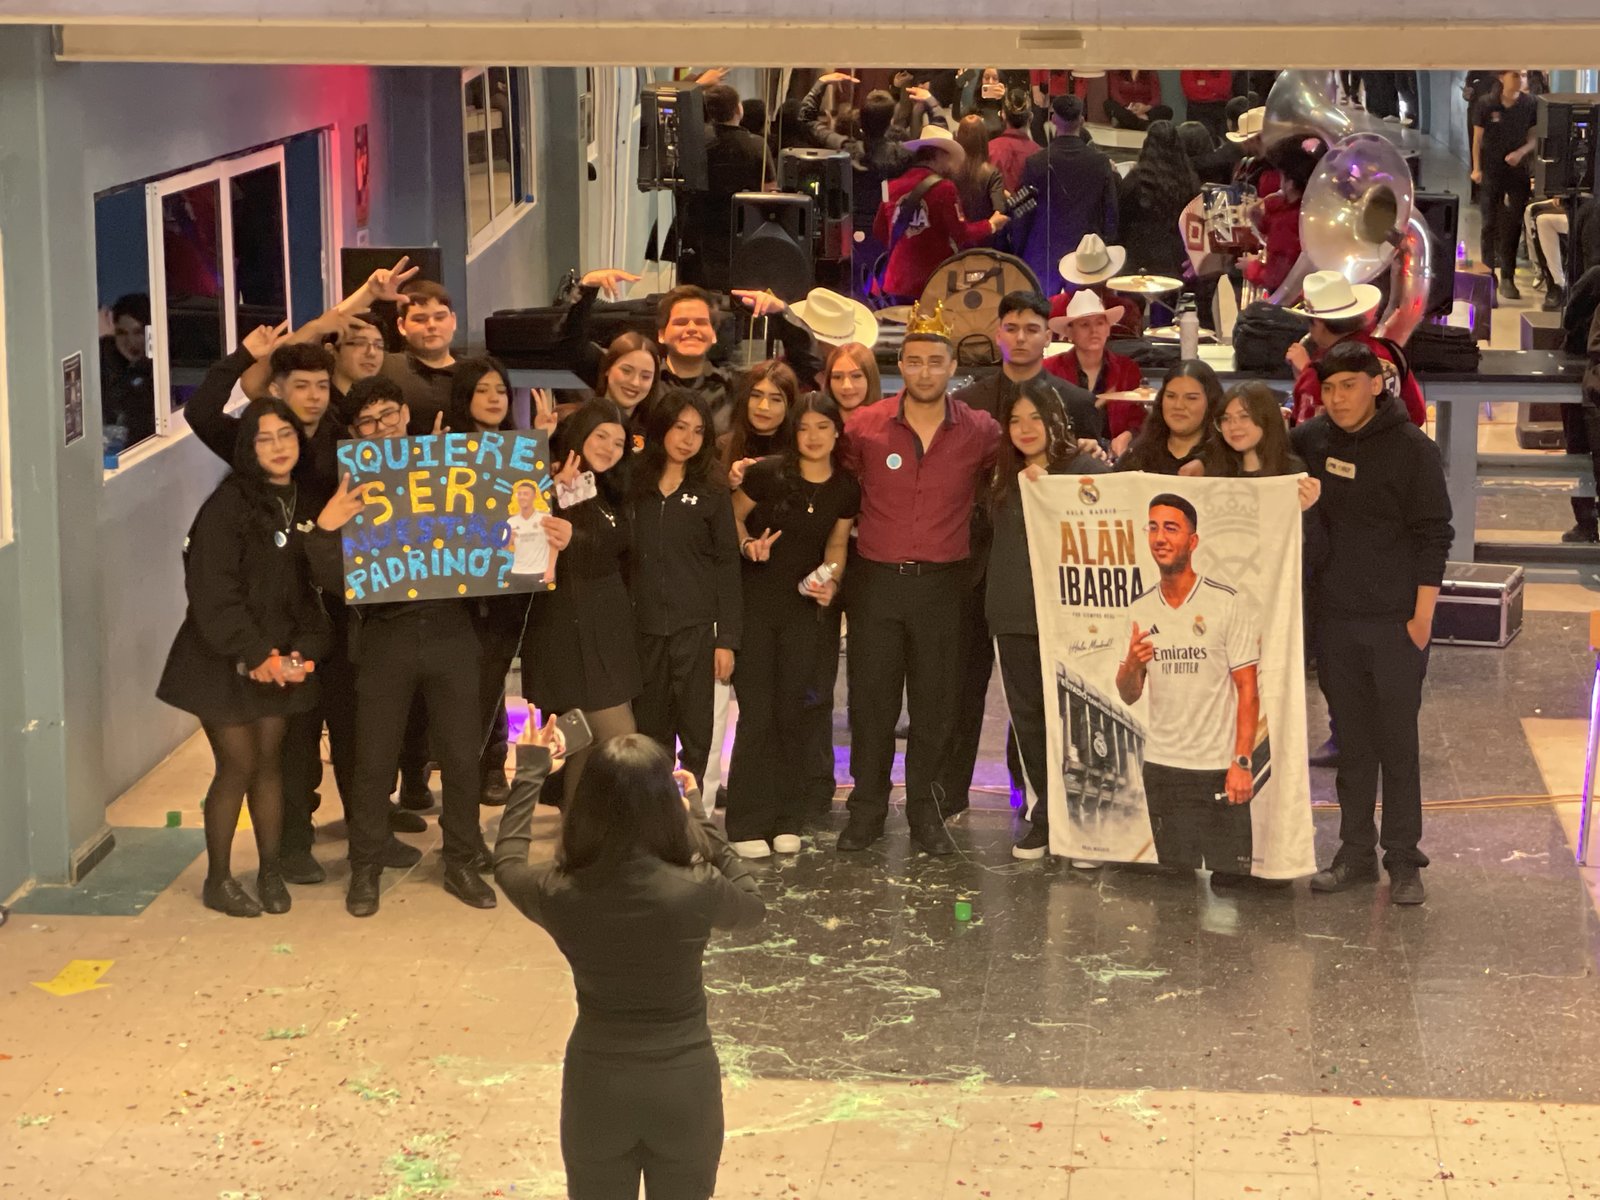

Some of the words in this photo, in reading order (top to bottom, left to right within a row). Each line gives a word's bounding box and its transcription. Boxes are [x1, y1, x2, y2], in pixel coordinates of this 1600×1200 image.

[362, 467, 477, 526] SER
[1060, 519, 1136, 566] ALAN
[346, 547, 514, 599] PADRINO?
[1059, 565, 1144, 607] IBARRA
[1153, 644, 1208, 662] Emirates
[1161, 662, 1172, 675] FLY
[1174, 662, 1199, 674] BETTER
